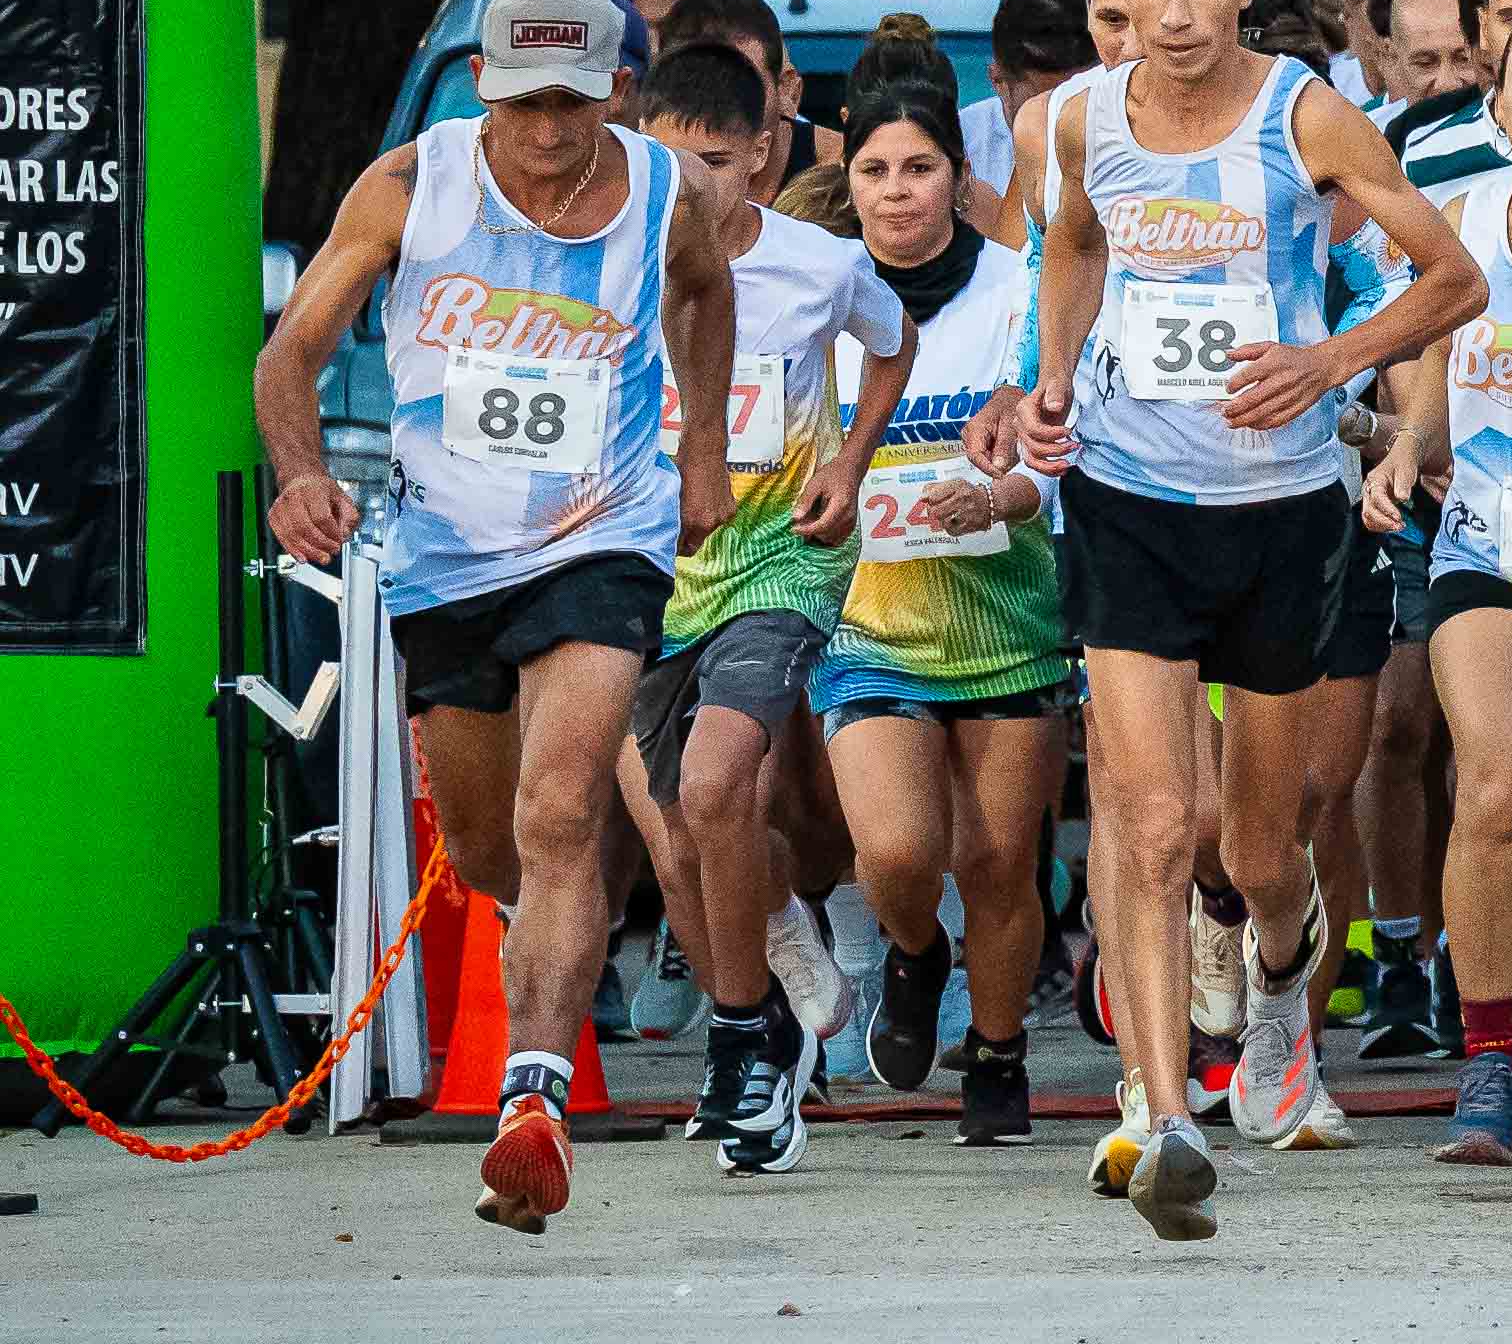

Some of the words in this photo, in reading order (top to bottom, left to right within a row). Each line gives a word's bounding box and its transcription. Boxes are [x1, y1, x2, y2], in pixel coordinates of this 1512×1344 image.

[56, 160, 119, 203] LAS
[17, 231, 86, 275] LOS
[1108, 199, 1267, 253] Beltrán
[1152, 317, 1237, 373] 38
[478, 387, 567, 445] 88
